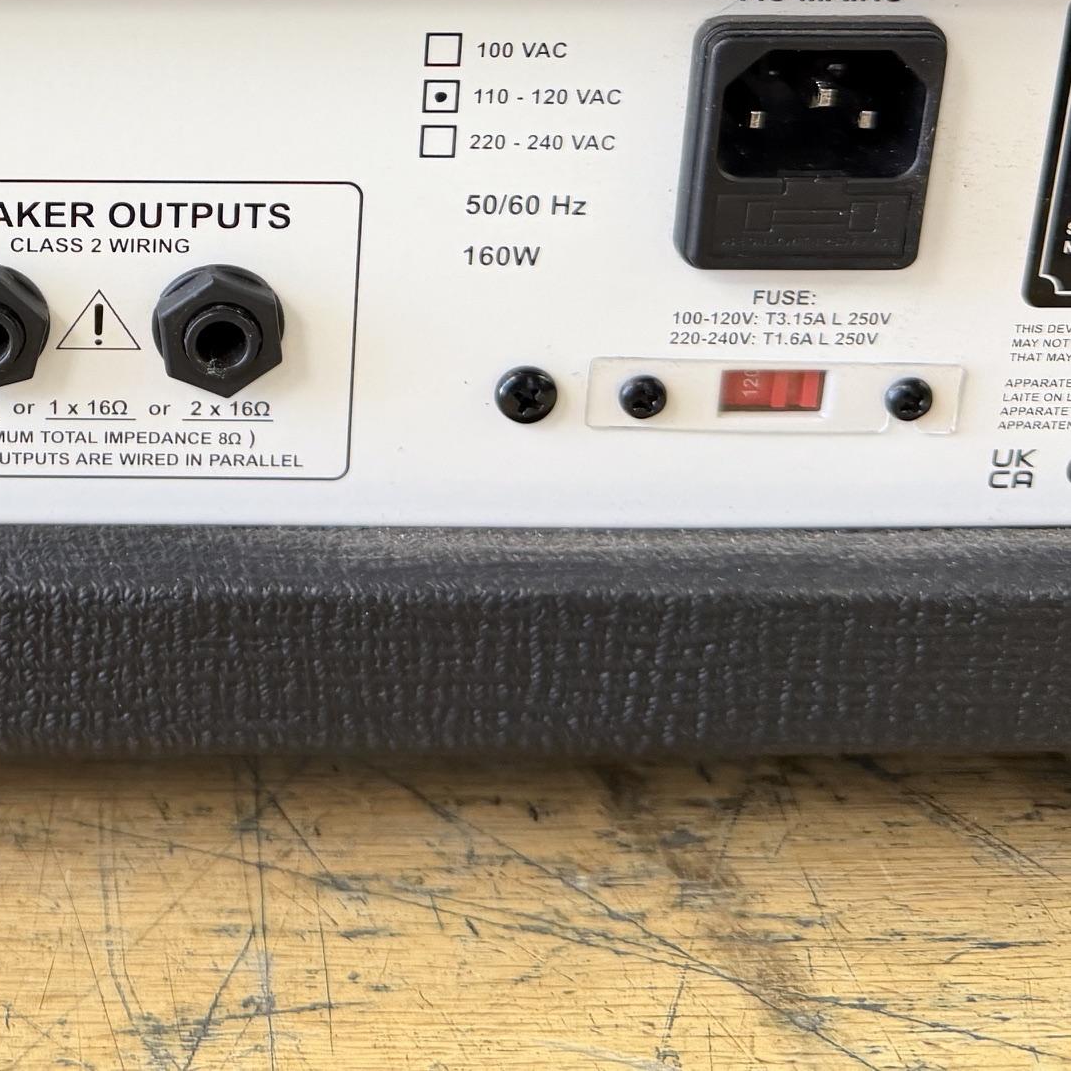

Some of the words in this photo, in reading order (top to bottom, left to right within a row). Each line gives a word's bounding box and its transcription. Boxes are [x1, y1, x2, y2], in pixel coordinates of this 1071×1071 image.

[477, 41, 514, 59] 100
[521, 42, 568, 59] VAC
[473, 88, 509, 105] 110
[531, 88, 568, 105] 120
[576, 89, 622, 105] VAC
[469, 134, 506, 150] 220
[526, 134, 564, 151] 240
[571, 134, 616, 151] VAC
[465, 194, 540, 216] 50/60
[551, 195, 587, 216] Hz
[108, 201, 291, 230] OUTPUTS
[10, 237, 84, 253] CLASS
[90, 237, 102, 253] 2
[108, 237, 190, 254] WIRING
[463, 245, 541, 267] 160W
[752, 289, 817, 306] FUSE:
[672, 311, 759, 325] 100-120V:
[765, 311, 827, 326] T3.15A
[831, 312, 843, 326] L
[847, 312, 892, 326] 250V
[1015, 323, 1044, 334] THIS
[669, 331, 756, 345] 220-240V:
[762, 331, 814, 346] T1.6A
[818, 332, 830, 346] L
[834, 332, 879, 346] 250V
[1011, 338, 1039, 348] MAY
[1042, 338, 1071, 348] NOT
[1010, 352, 1043, 362] THAT
[1002, 392, 1040, 402] LAITE
[1043, 392, 1063, 402] ON
[12, 402, 36, 415] or
[49, 399, 57, 415] 1
[67, 403, 79, 415] x
[87, 399, 128, 416] 16Ω
[148, 404, 171, 416] or
[190, 400, 202, 416] 2
[210, 404, 221, 417] x
[229, 400, 271, 417] 16Ω
[1000, 406, 1070, 416] APPARATE
[40, 430, 98, 444] TOTAL
[104, 431, 212, 445] IMPEDANCE
[218, 432, 242, 446] 8Ω
[75, 452, 113, 466] ARE
[119, 452, 179, 466] WIRED
[185, 453, 202, 467] IN
[209, 453, 303, 468] PARALLEL
[992, 449, 1036, 468] UK
[988, 470, 1034, 489] CA
